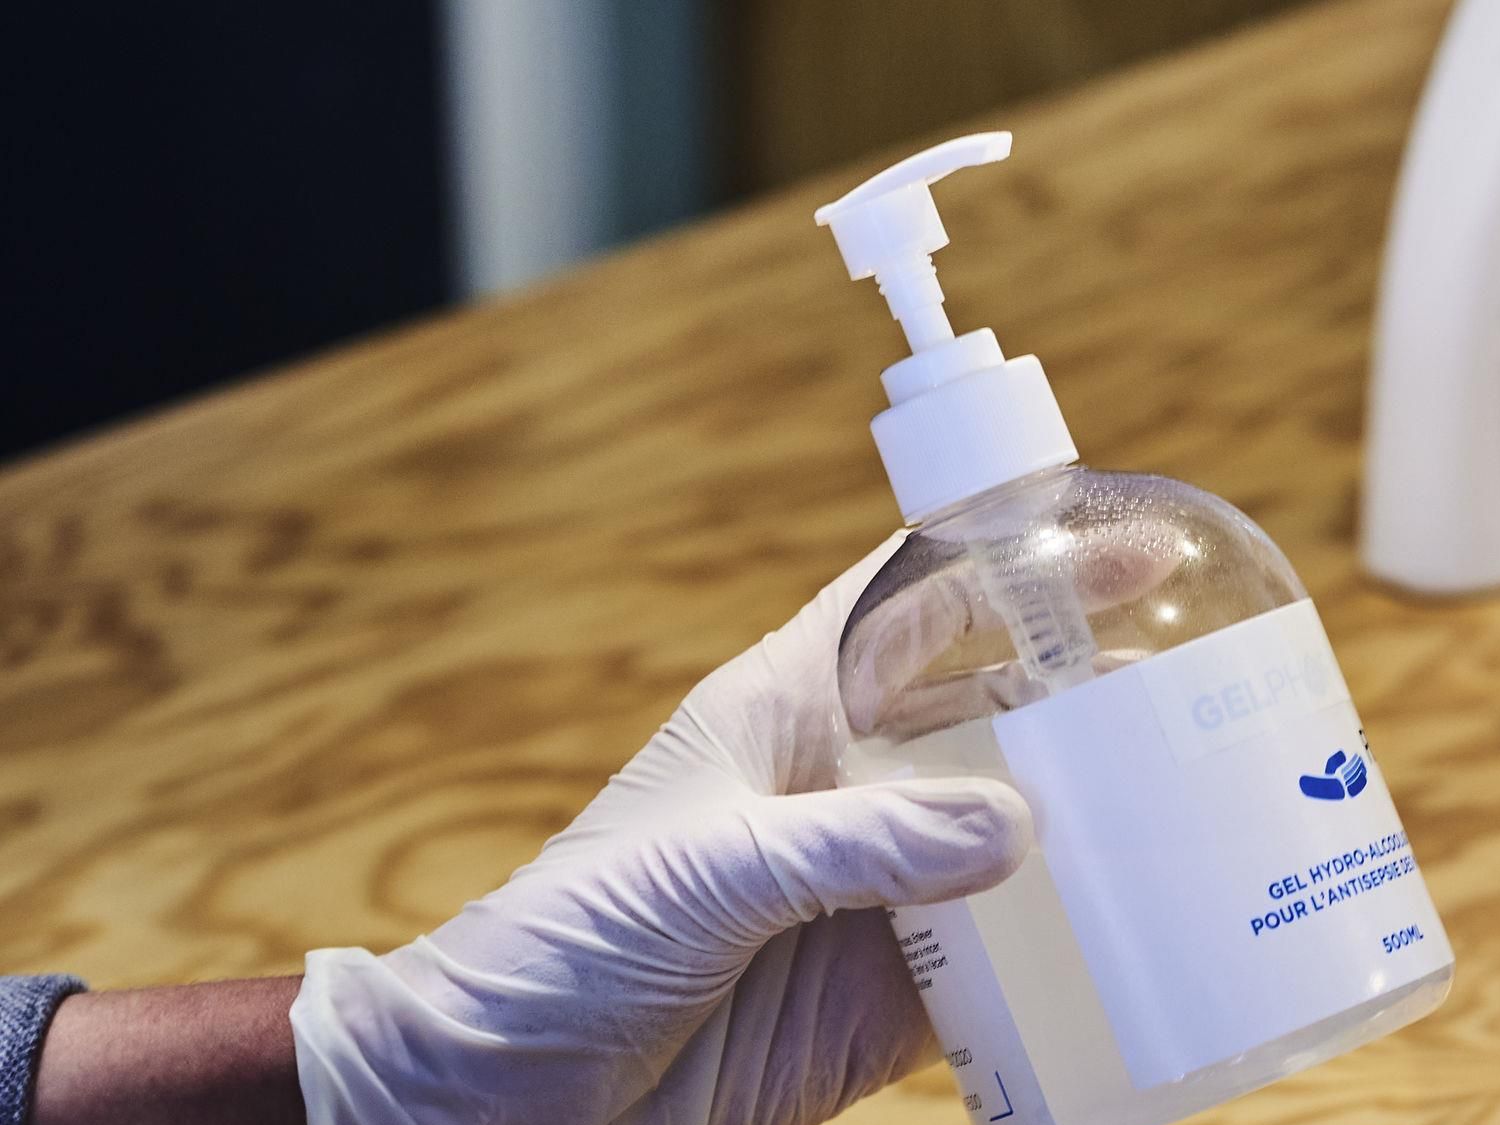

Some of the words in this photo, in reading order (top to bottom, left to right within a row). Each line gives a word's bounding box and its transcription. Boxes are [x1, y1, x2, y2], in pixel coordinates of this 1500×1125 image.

[1250, 901, 1308, 936] POUR
[1310, 861, 1401, 912] L'ANTISEPSIE
[1268, 874, 1307, 900] GEL
[1382, 924, 1424, 954] 500ML
